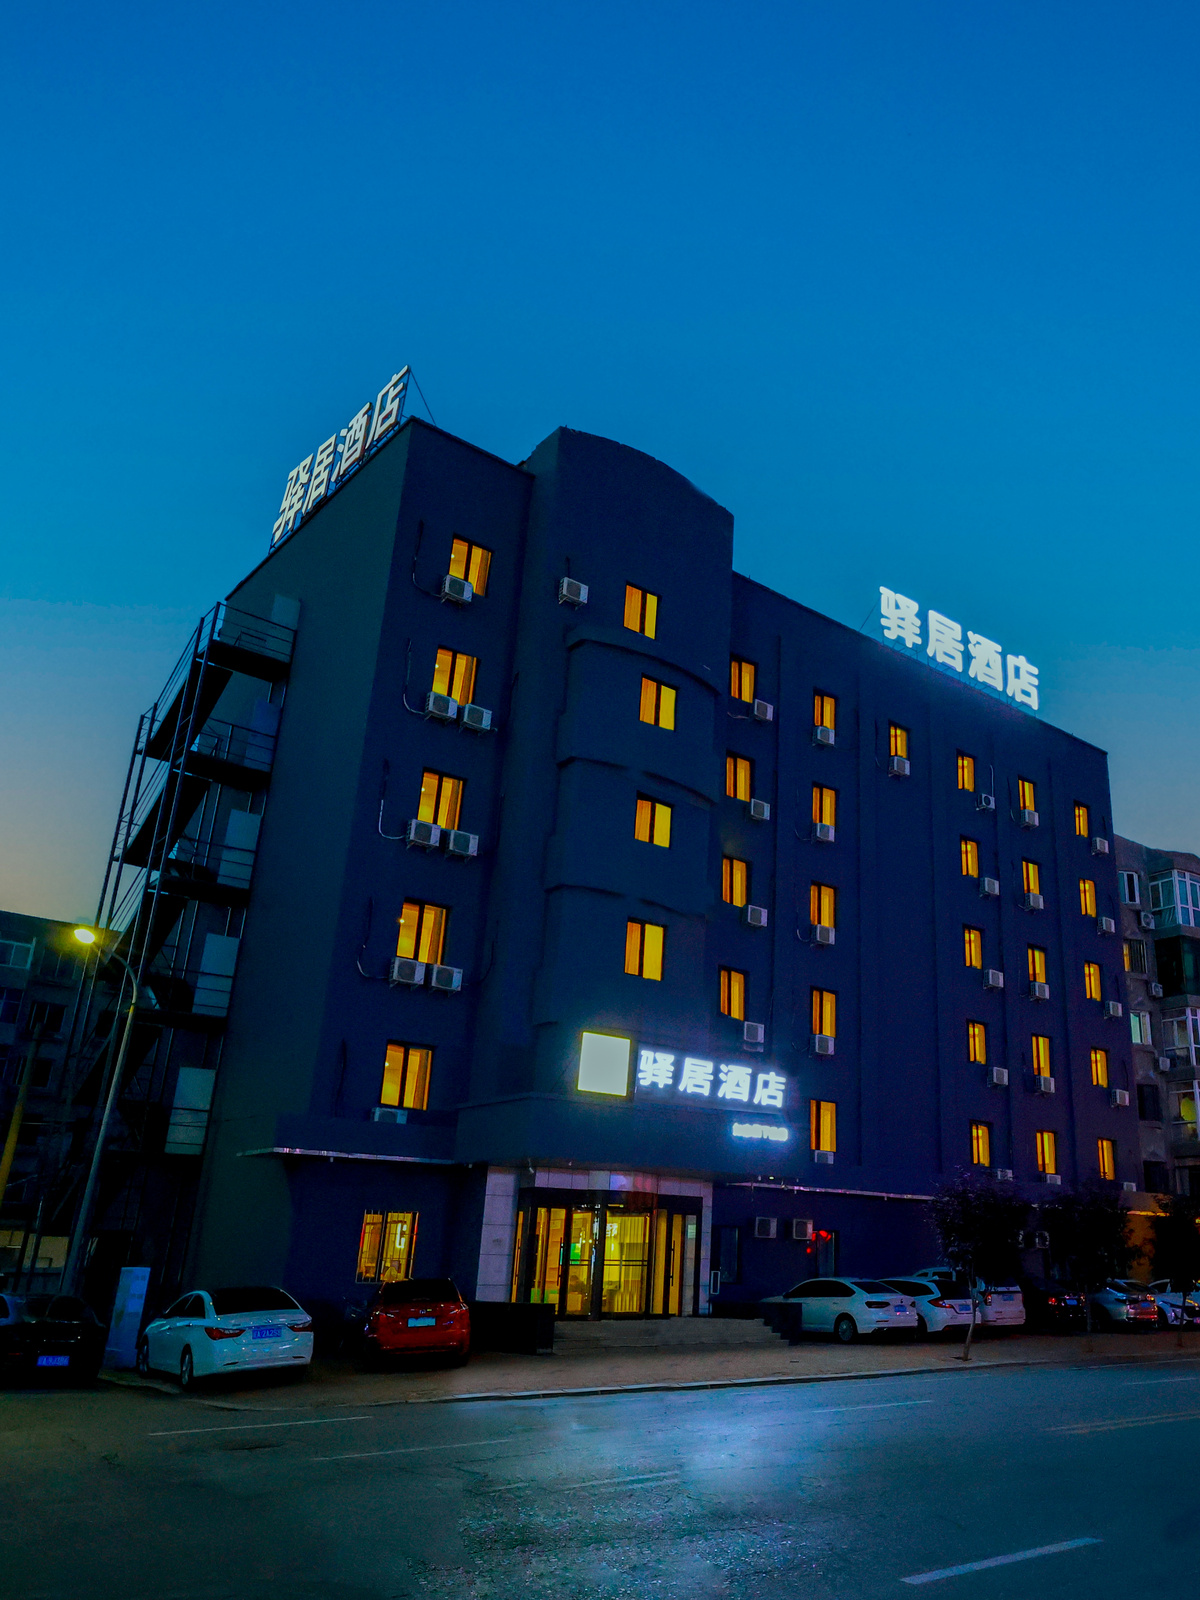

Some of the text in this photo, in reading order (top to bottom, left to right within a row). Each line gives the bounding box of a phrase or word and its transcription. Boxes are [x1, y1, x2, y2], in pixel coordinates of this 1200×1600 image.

[272, 365, 409, 544] 驿居酒店
[879, 586, 1039, 710] 驿居酒店
[638, 1050, 786, 1108] 驿居酒店
